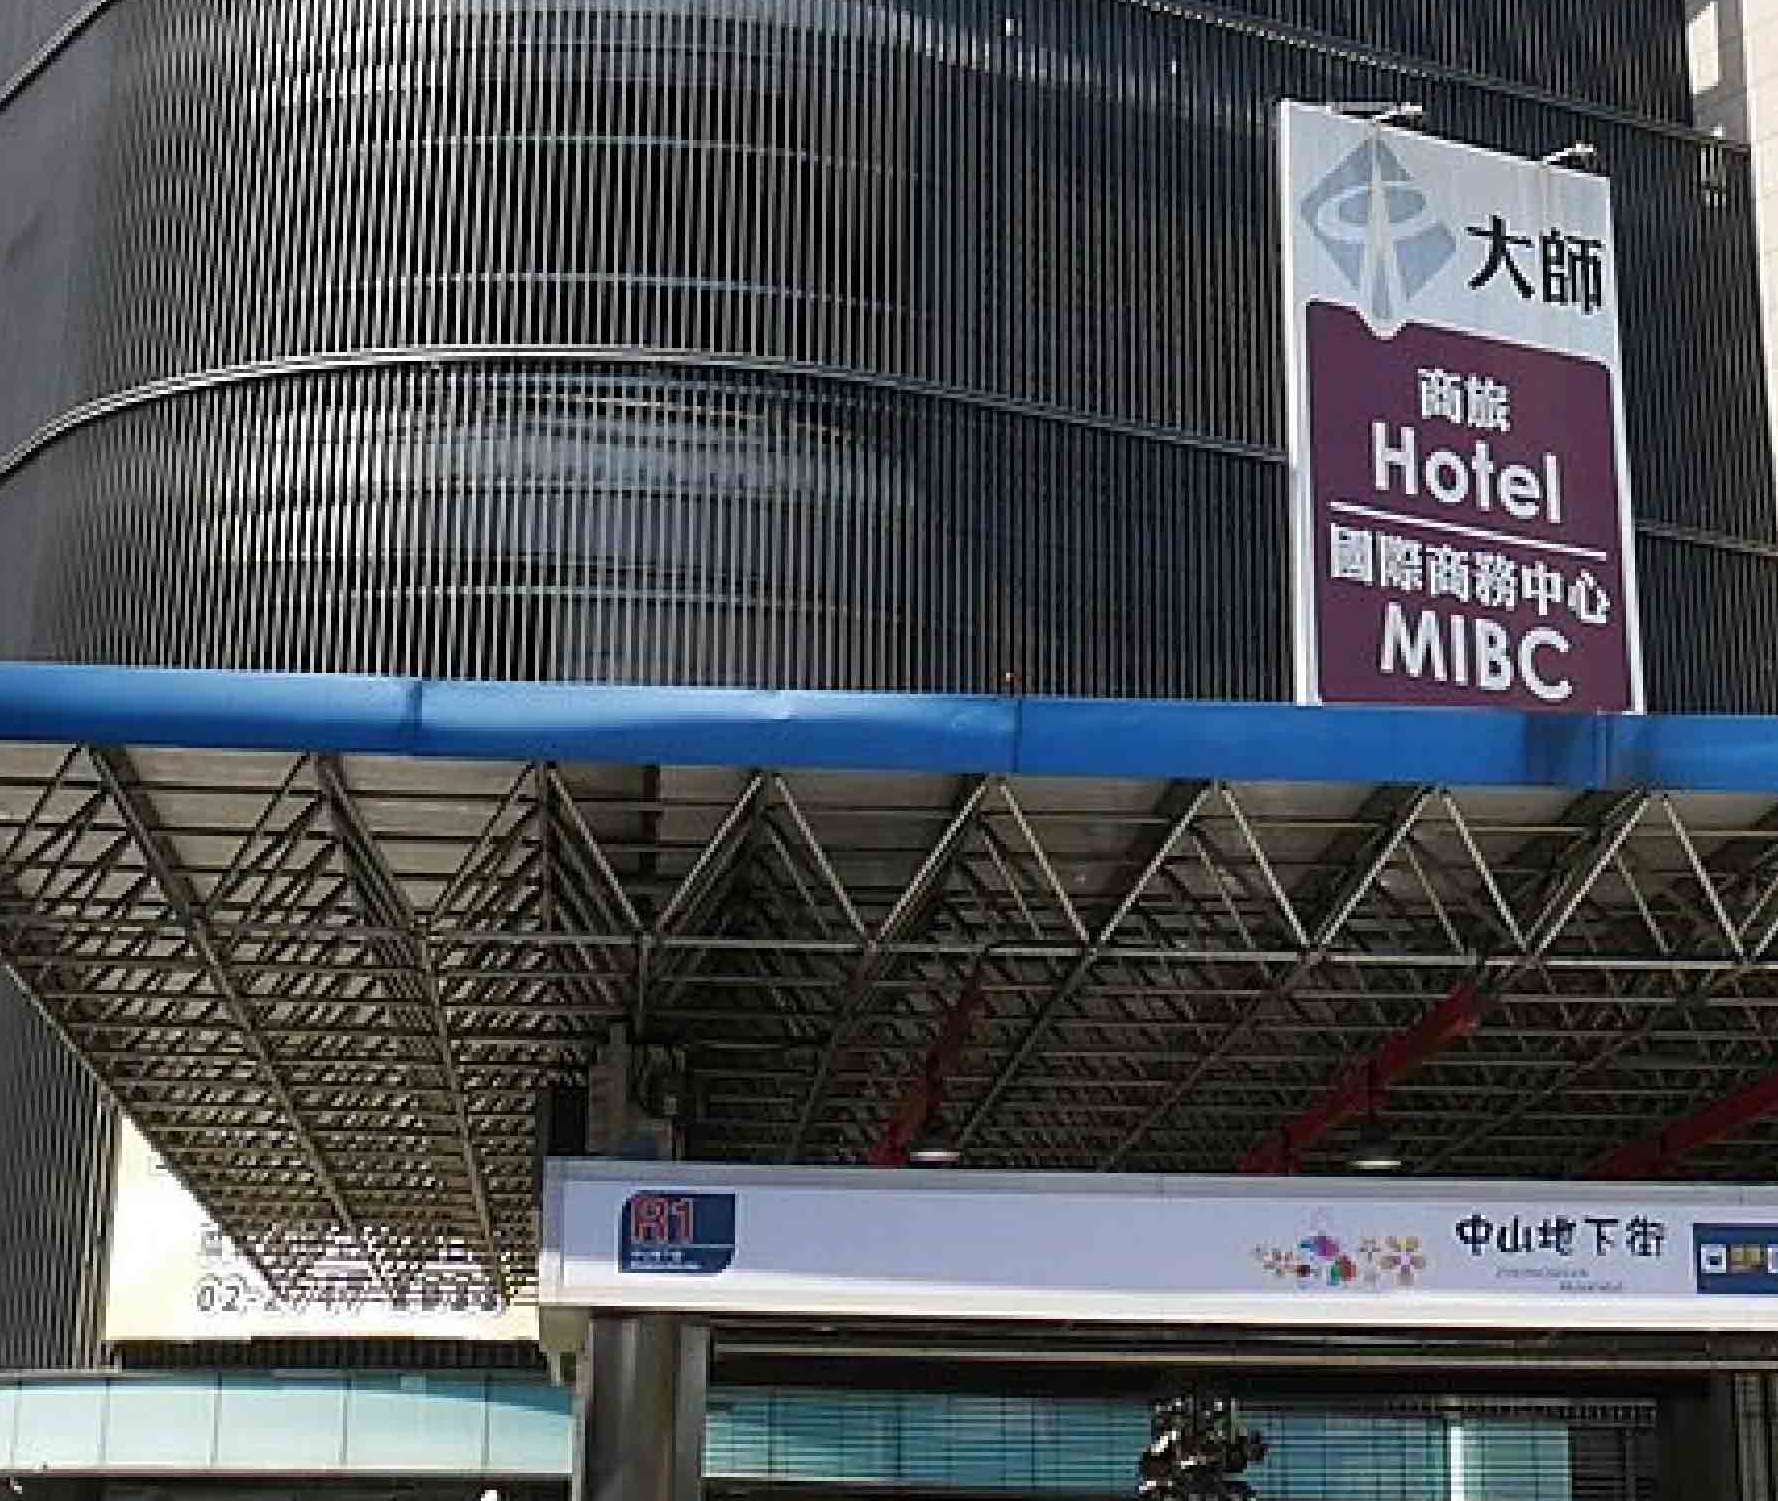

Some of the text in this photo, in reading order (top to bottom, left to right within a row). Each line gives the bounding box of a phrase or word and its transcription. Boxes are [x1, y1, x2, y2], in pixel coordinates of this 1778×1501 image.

[1464, 214, 1604, 314] 大師
[1419, 367, 1512, 433] 商旅
[1372, 421, 1563, 525] Hotel
[1328, 521, 1612, 626] 國際商務中心
[1379, 600, 1574, 702] MIBC
[631, 1195, 695, 1246] R1
[1454, 1211, 1666, 1259] 中山地下街
